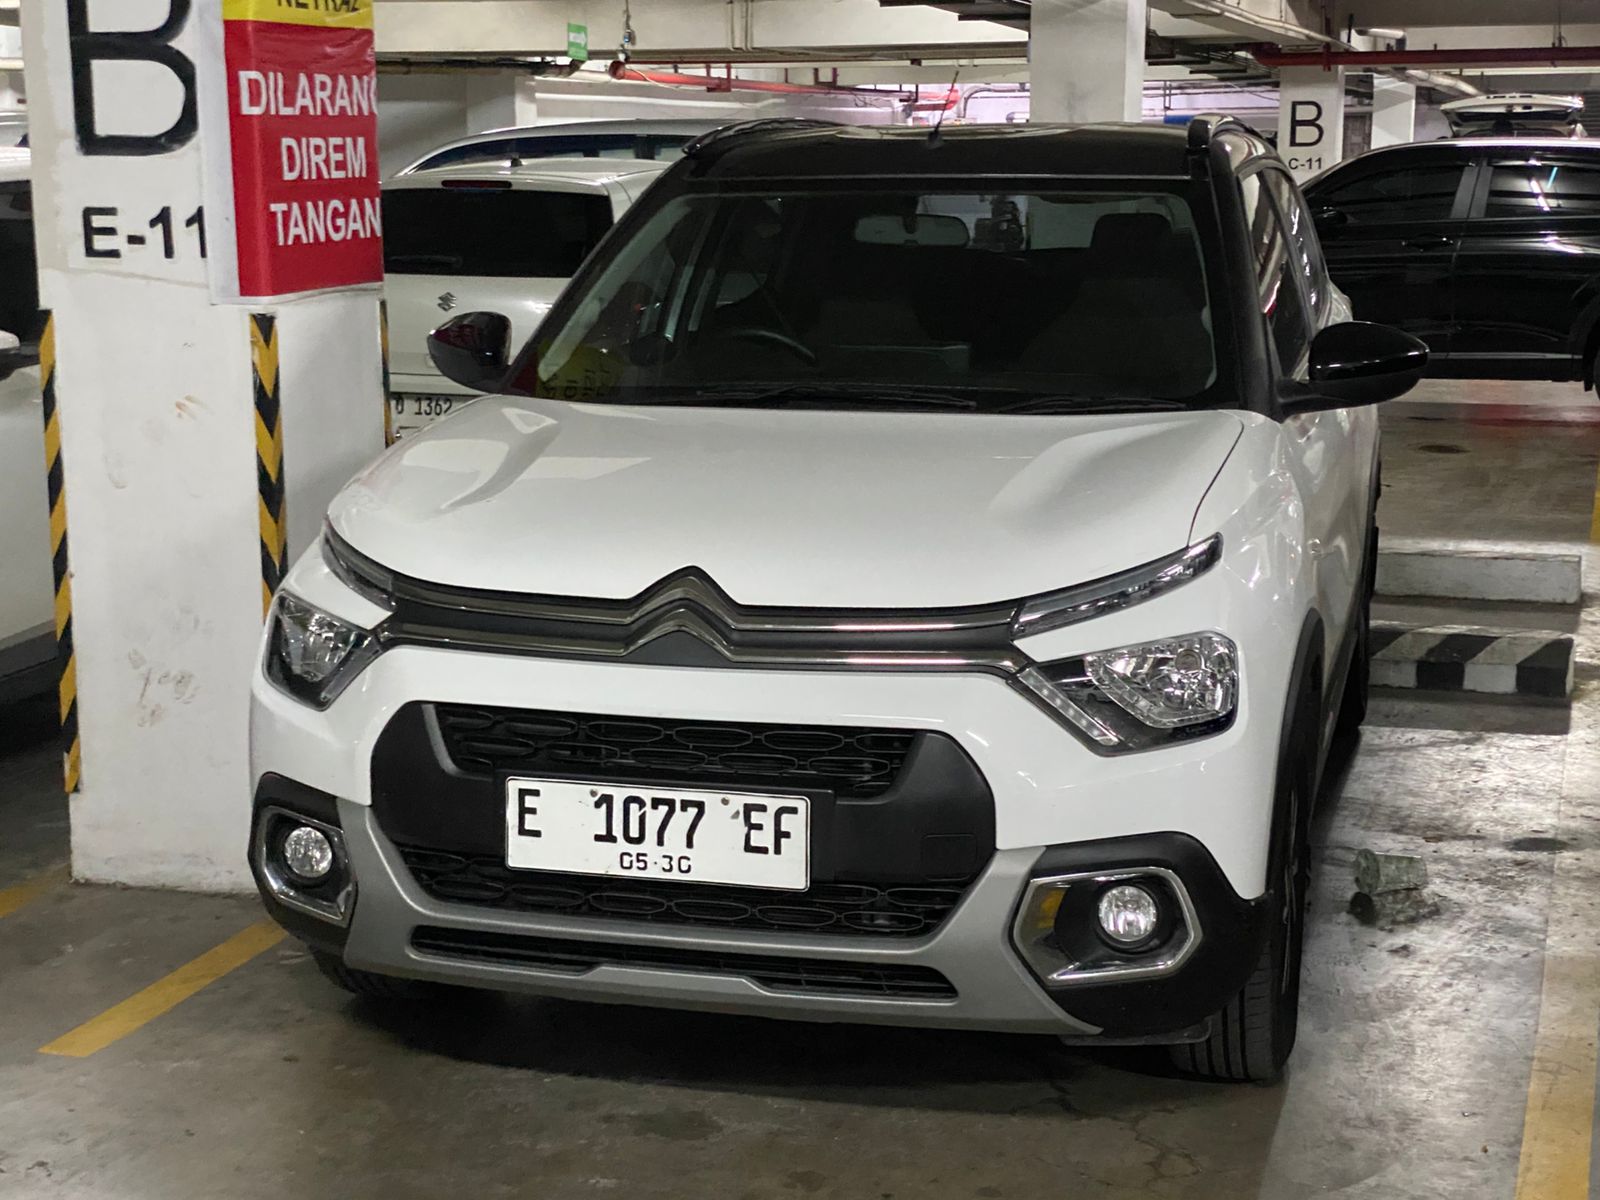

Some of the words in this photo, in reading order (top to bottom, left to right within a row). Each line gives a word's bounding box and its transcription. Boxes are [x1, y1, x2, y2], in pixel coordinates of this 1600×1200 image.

[67, 0, 199, 156] B
[1289, 101, 1324, 147] B
[281, 136, 367, 181] DIREM
[1288, 156, 1322, 170] C-11
[82, 205, 208, 259] E-11
[269, 197, 382, 246] TANGAN
[414, 397, 453, 416] 1362
[517, 787, 543, 838] E
[593, 793, 706, 849] 1077
[743, 802, 799, 855] EF
